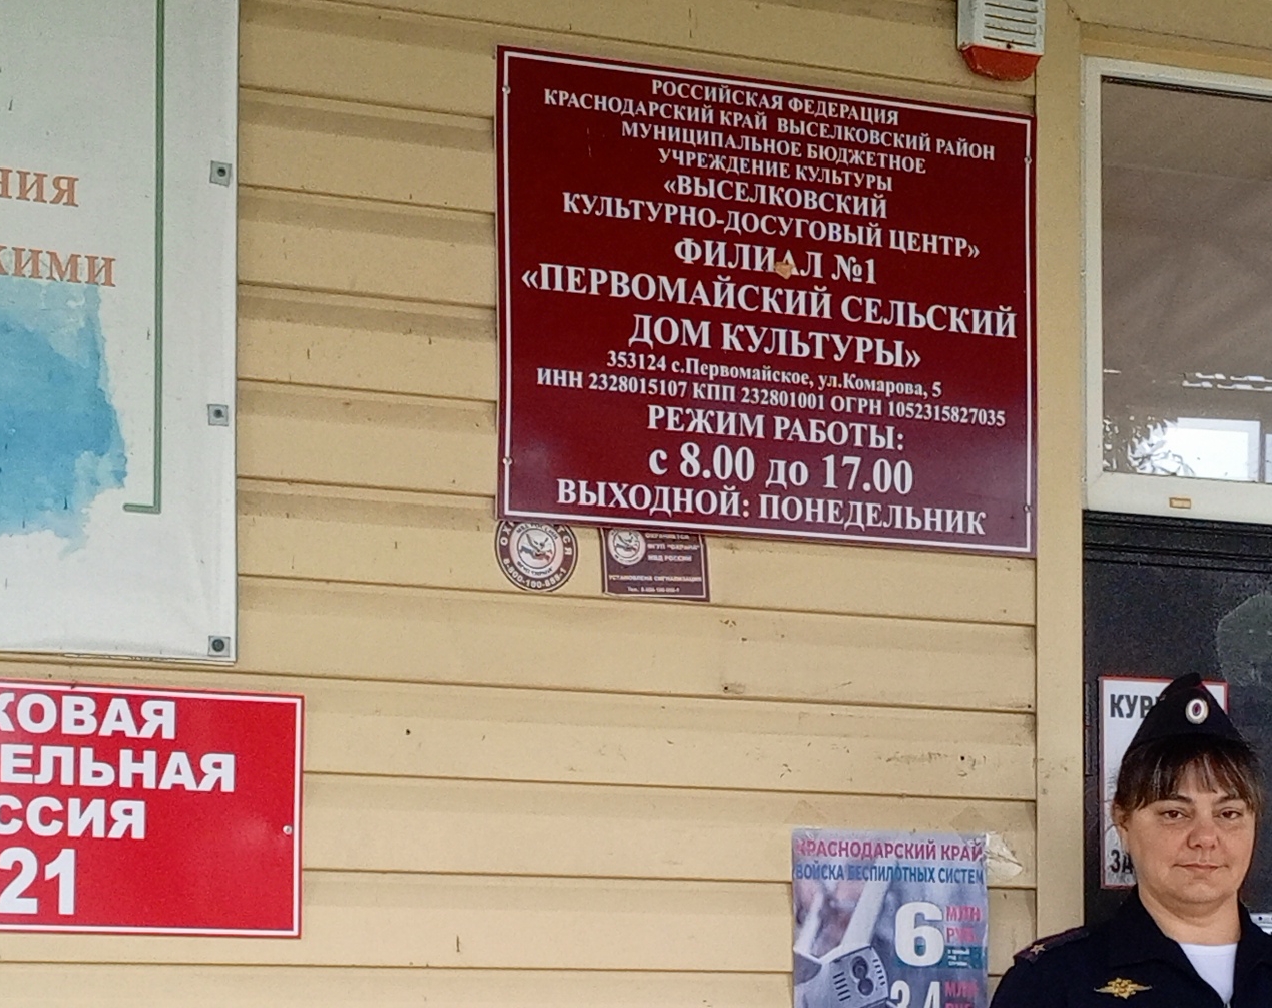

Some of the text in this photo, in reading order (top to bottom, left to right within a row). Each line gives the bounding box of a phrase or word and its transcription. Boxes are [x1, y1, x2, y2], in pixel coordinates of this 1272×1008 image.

[544, 88, 996, 161] КРАСНОДАРСКИЙ КРАЙ ВЫСЕЛКОВСКИЙ РАЙОН
[651, 78, 900, 127] РОССИЙСКАЯ ФЕДЕРАЦИЯ
[621, 120, 926, 175] МУНИЦИПАЛЬНОЕ БЮДЖЕТНОЕ
[658, 147, 893, 193] УЧРЕЖДЕНИЕ КУЛЬТУРЫ
[663, 173, 888, 220] «ВЫСЕЛКОВСКИЙ
[562, 192, 980, 258] КУЛЬТУРНО-ДОСУГОВЫЙ ЦЕНТР»
[674, 237, 878, 285] ФИЛИАЛ №1
[521, 262, 1018, 339] «ПЕРВОМАЙСКИЙ СЕЛЬСКИЙ
[628, 313, 922, 370] ДОМ КУЛЬТУРЫ»
[536, 367, 1006, 427] ИНН 2328015107 КПП 232801001 ОГРН 1052315827035
[606, 350, 942, 399] 353124 с.Первомайское, ул.Комарова, 5
[646, 404, 904, 451] РЕЖИМ РАБОТЫ:
[648, 442, 914, 494] с 8.00 до 17.00
[556, 478, 987, 537] ВЫХОДНОЙ: ПОНЕДЕЛЬНИК
[1110, 694, 1160, 718] КУР
[795, 861, 984, 885] ВОЙСКА БЕСПИЛОТНЫХ СИСТЕМ
[796, 840, 984, 862] КРАСНОДАРСКИЙ КРАЙ
[895, 901, 945, 967] 6
